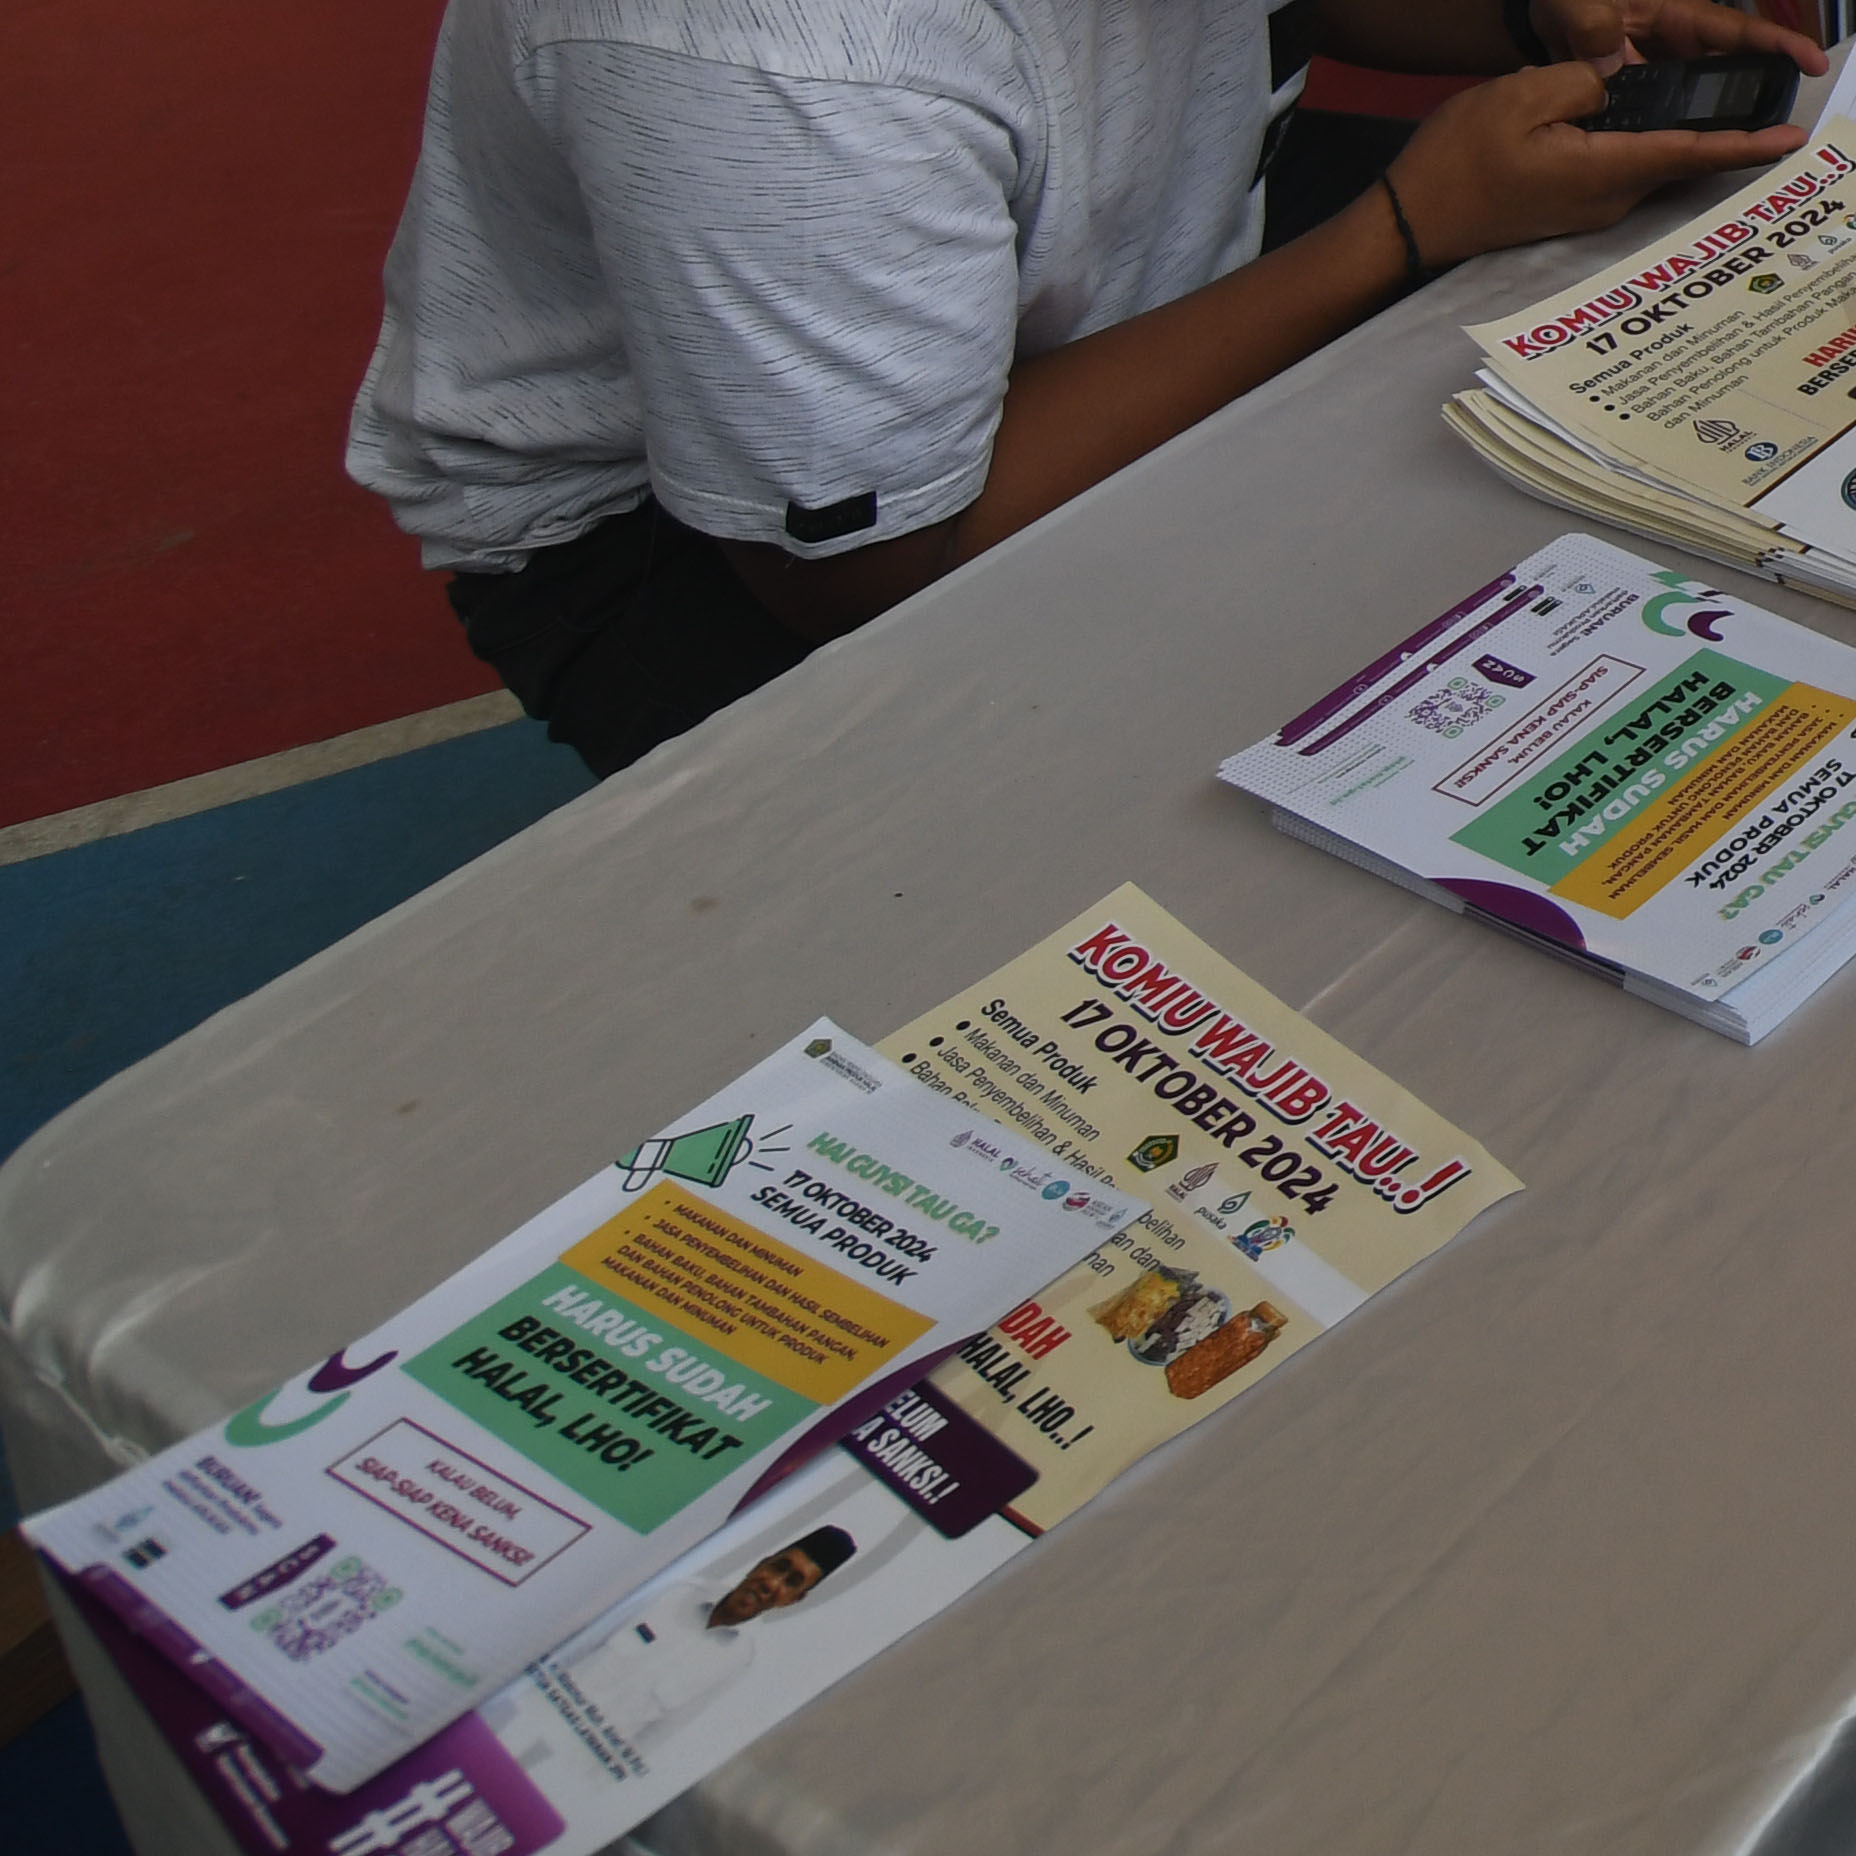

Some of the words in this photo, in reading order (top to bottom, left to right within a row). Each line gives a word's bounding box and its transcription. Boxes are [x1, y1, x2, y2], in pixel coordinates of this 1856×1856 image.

[1503, 285, 1642, 360] KOMIU
[1630, 220, 1759, 293] WAJIB
[1585, 333, 1619, 356] 17
[1621, 246, 1774, 336] OKTOBER
[1767, 198, 1846, 248] 2024
[1569, 360, 1632, 394] Semua
[1630, 323, 1694, 361] Produk
[1600, 359, 1663, 397] Makanan
[1662, 345, 1685, 363] dan
[1685, 310, 1745, 346] Minuman
[1663, 409, 1691, 429] dan
[1690, 374, 1750, 412] Minuman
[1548, 666, 1609, 716] SIAP-SIAP
[1553, 700, 1592, 732] KALAU
[1604, 671, 1710, 745] HALAL,
[1506, 716, 1547, 745] KENA
[1664, 692, 1763, 770] HARUS
[1793, 722, 1837, 761] MAKANAN
[1521, 681, 1736, 857] BERSERTIFIKAT
[1534, 750, 1609, 810] LHO!
[1722, 777, 1770, 821] MINUMAN
[1769, 761, 1792, 781] DAN
[1772, 759, 1842, 814] SEMUA
[1558, 769, 1666, 857] SUDAH
[1751, 787, 1837, 855] OKTOBER
[1685, 815, 1775, 888] PRODUK
[1709, 854, 1758, 890] 2024
[1760, 849, 1811, 886] TAU
[1718, 884, 1765, 920] GA?
[981, 998, 1040, 1049] Semua
[1037, 1041, 1100, 1095] Produk
[1067, 924, 1221, 1037] KOMIU
[1188, 1015, 1333, 1126] WAJIB
[938, 1046, 970, 1074] Jasa
[969, 1067, 1059, 1150] Penyembelihan
[964, 1028, 1020, 1077] Makanan
[1016, 1066, 1046, 1096] dan
[1040, 1089, 1100, 1142] Minuman
[1061, 998, 1114, 1029] 17
[1095, 1024, 1257, 1148] OKTOBER
[1238, 1135, 1339, 1216] 2024
[783, 1170, 812, 1188] 17
[802, 1181, 894, 1238] OKTOBER
[884, 1229, 939, 1263] 2024
[807, 1131, 855, 1164] HAI
[905, 1184, 958, 1220] TAU
[947, 1211, 1001, 1245] GA?
[673, 1204, 727, 1239] MAKANAN
[724, 1233, 752, 1251] DAN
[748, 1244, 804, 1278] MINUMAN
[751, 1186, 828, 1235] SEMUA
[819, 1227, 919, 1286] PRODUK
[601, 1257, 660, 1292] MAKANAN
[655, 1286, 685, 1306] DAN
[680, 1300, 738, 1336] MINUMAN
[617, 1245, 645, 1262] DAN
[641, 1259, 683, 1286] BAHAN
[679, 1280, 743, 1319] PENOLONG
[739, 1312, 783, 1339] UNTUK
[778, 1334, 830, 1365] PRODUK
[632, 1233, 674, 1260] BAHAN
[705, 1270, 747, 1300] BAHAN
[746, 1294, 811, 1334] TAMBAHAN
[652, 1219, 683, 1240] JASA
[763, 1277, 792, 1297] DAN
[788, 1290, 821, 1314] HASIL
[818, 1309, 890, 1349] SEMBELIHAN
[541, 1284, 663, 1358] HARUS
[645, 1347, 774, 1423] SUDAH
[997, 1301, 1072, 1361] DAH
[451, 1346, 564, 1428] HALAL,
[558, 1412, 656, 1472] LHO!
[498, 1315, 744, 1461] BERSERTIFIKAT
[885, 1388, 950, 1442] ELUM
[426, 1460, 477, 1490] KALAU
[426, 1500, 474, 1532] KENA
